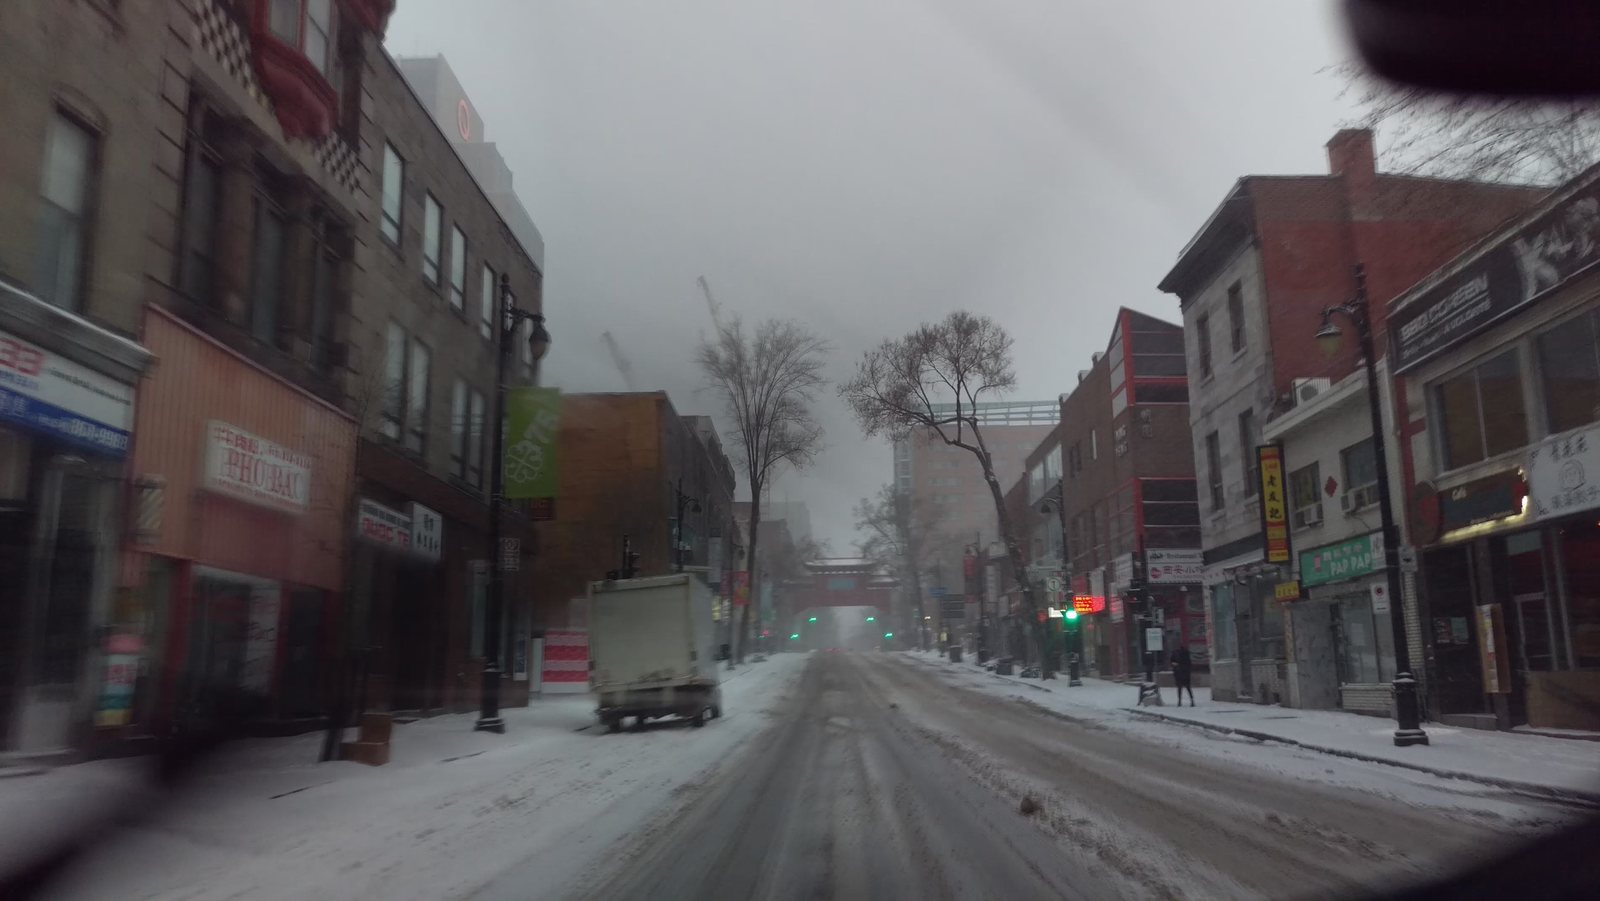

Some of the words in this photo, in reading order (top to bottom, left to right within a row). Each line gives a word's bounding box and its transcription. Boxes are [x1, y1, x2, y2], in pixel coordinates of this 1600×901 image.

[227, 449, 263, 486] PHO
[1330, 558, 1348, 577] PAP
[1351, 552, 1371, 571] PAP
